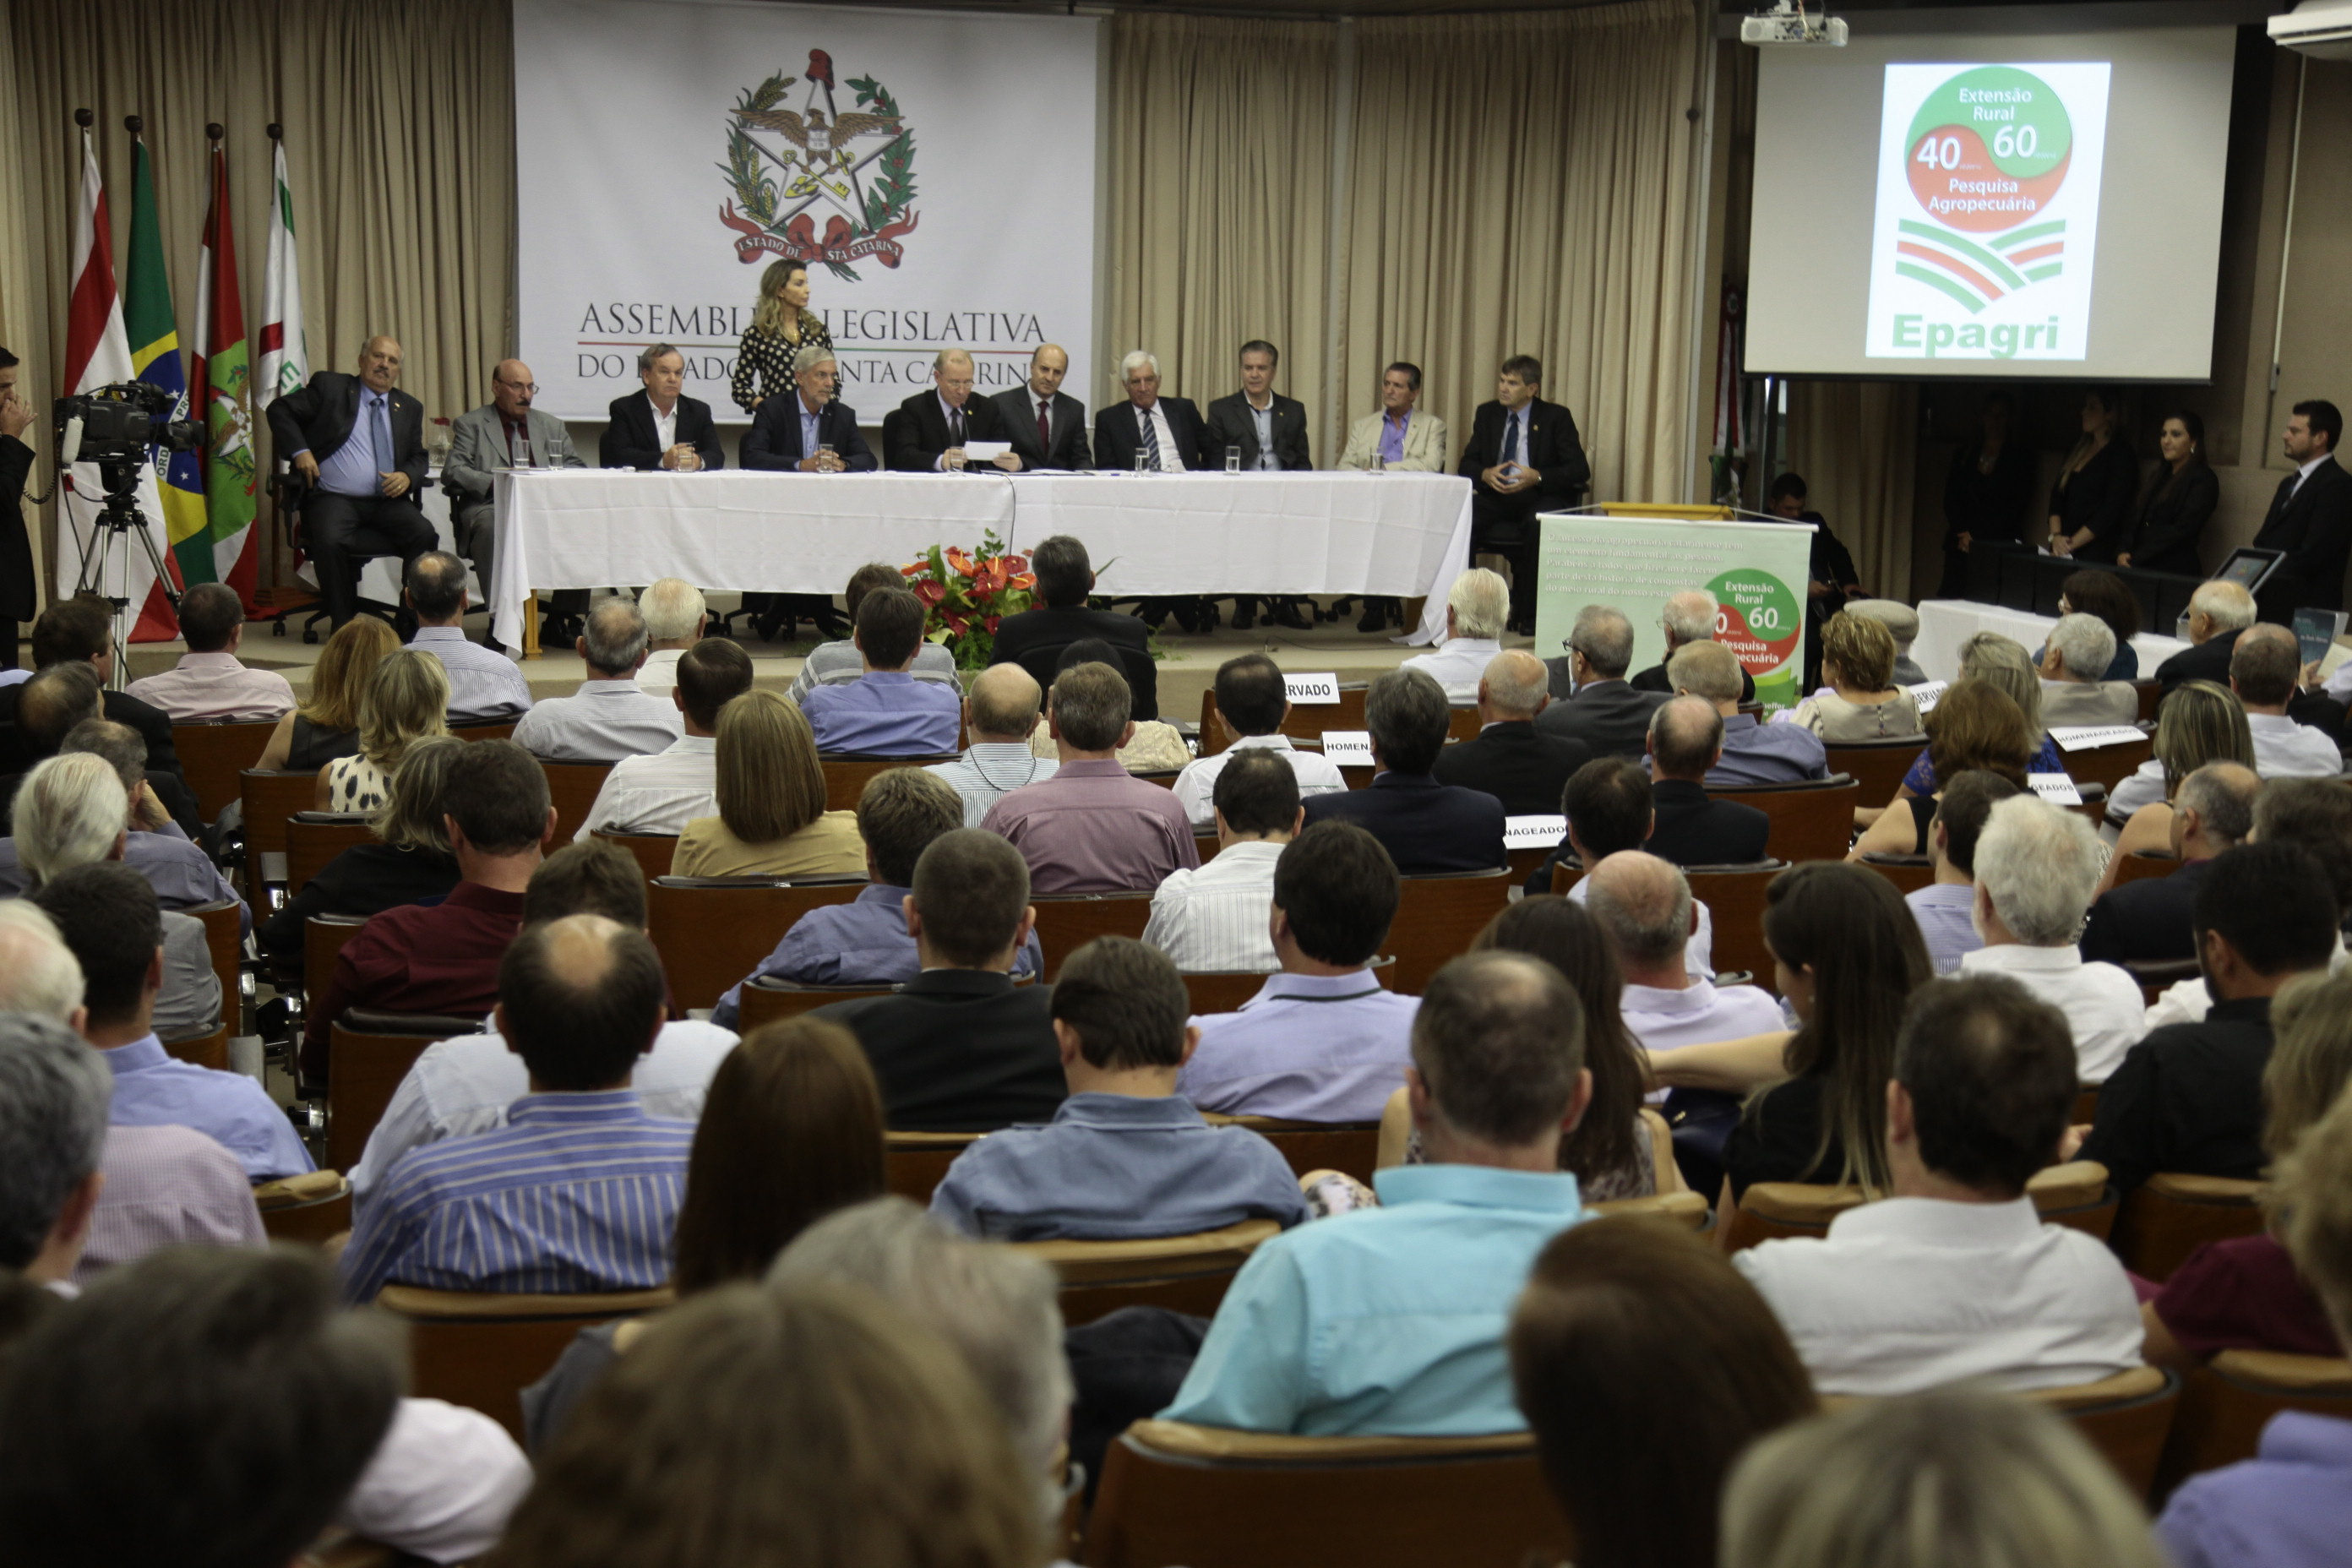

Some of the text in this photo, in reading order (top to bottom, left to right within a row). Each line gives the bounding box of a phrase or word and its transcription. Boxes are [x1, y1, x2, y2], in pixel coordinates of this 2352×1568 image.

[1958, 87, 2033, 103] Extensão
[1973, 105, 2016, 122] Rural
[1992, 124, 2038, 159] 60
[1916, 136, 1962, 171] 40
[1948, 177, 2019, 196] Pesquisa
[1928, 195, 2037, 215] Agropecuária
[738, 236, 785, 252] ESTADO
[827, 248, 848, 261] STA
[850, 240, 901, 258] CATARINA
[579, 302, 1047, 343] ASSEMBL LEGISLATIVA
[1892, 314, 2059, 359] Epagri
[578, 353, 624, 378] DO
[841, 360, 899, 384] NTA
[156, 449, 169, 476] ORD
[1559, 535, 1592, 543] sucesso
[1594, 535, 1605, 544] da
[1608, 537, 1667, 547] agropecuária
[1669, 539, 1722, 548] catarinense
[1564, 547, 1607, 557] elemento
[1598, 561, 1623, 569] todos
[1625, 564, 1643, 572] que
[1645, 564, 1680, 574] fizeram
[1690, 565, 1718, 575] fazem
[1546, 572, 1698, 586] parte desta história de conquistas
[1725, 580, 1775, 594] Extensão
[1546, 583, 1557, 592] do
[1560, 585, 1582, 593] meio
[1585, 585, 1605, 595] rural
[1608, 586, 1620, 596] do
[1650, 591, 1671, 599] esta
[1735, 593, 1763, 604] Rural
[1715, 612, 1729, 635] 0
[1749, 607, 1778, 629] 60
[1721, 639, 1767, 653] Pesquisa
[1287, 683, 1331, 696] RVADO
[1326, 743, 1369, 751] HOMEN
[2031, 783, 2075, 792] GEADOS
